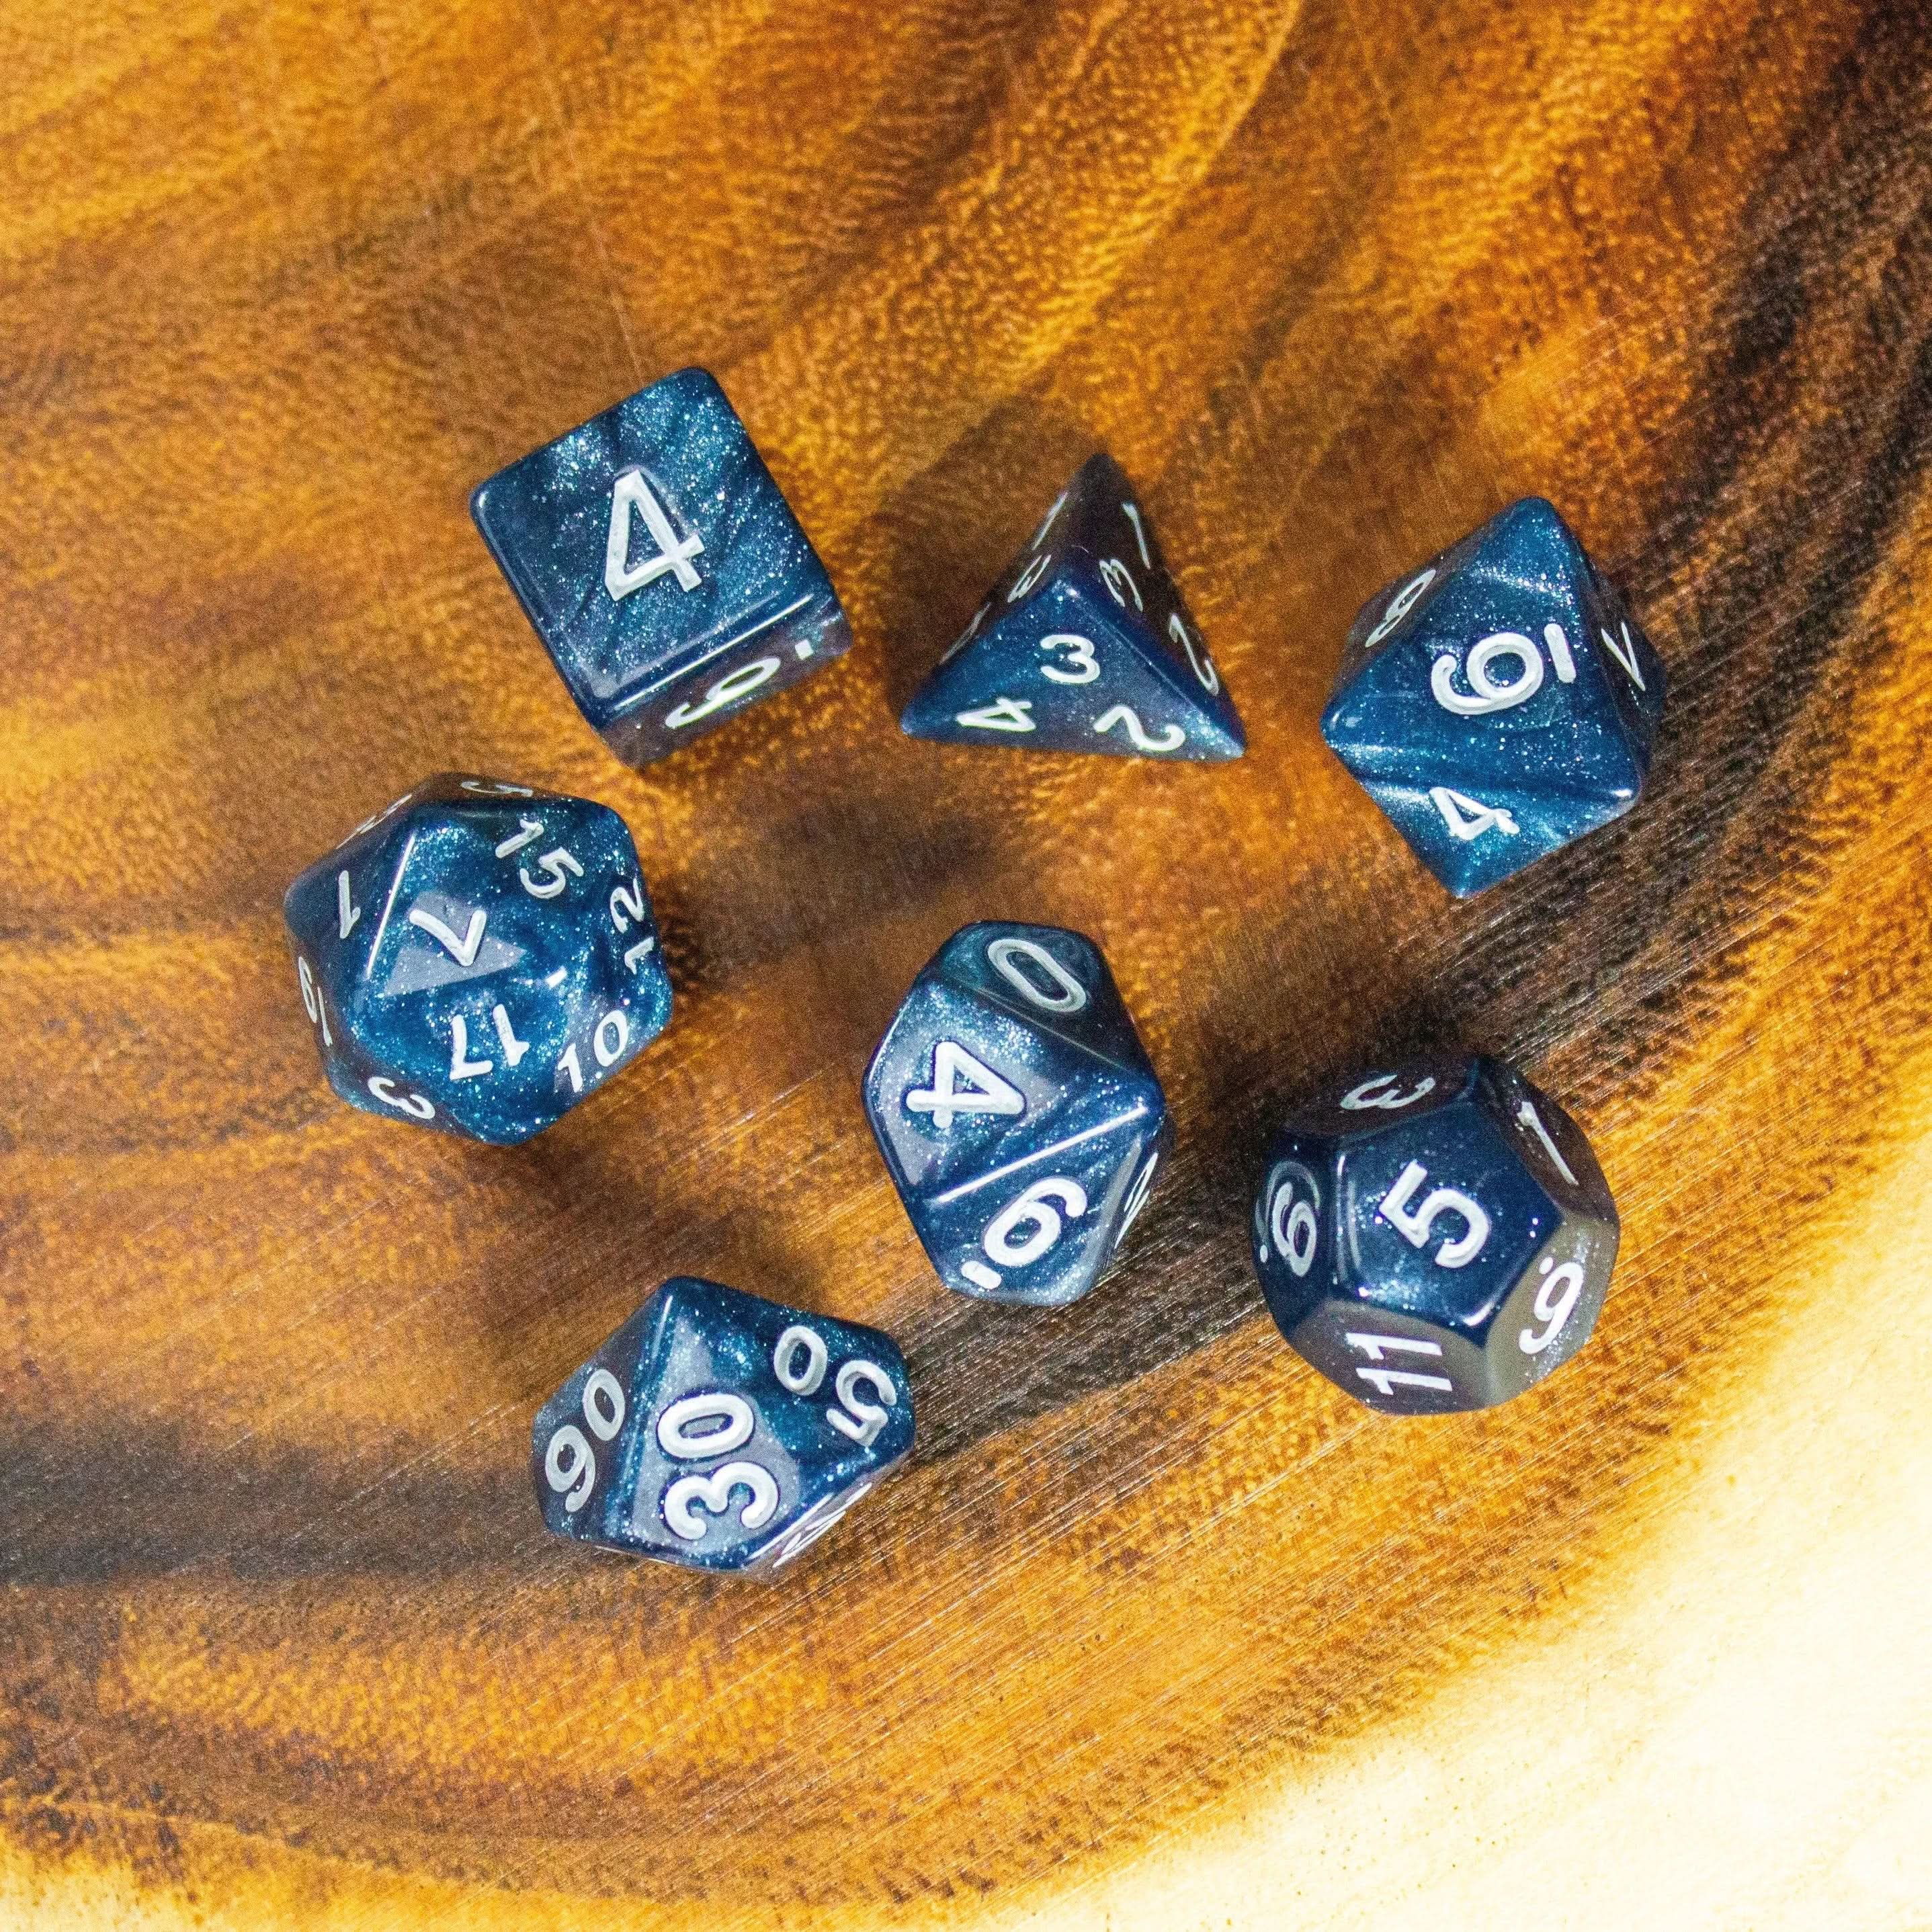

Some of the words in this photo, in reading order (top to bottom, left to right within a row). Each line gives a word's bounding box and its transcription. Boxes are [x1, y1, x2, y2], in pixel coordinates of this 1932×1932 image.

[605, 470, 705, 601] 4
[1099, 558, 1143, 612] 3
[1040, 634, 1101, 684] 3
[956, 696, 1036, 732] 4
[1093, 704, 1186, 753] 2
[1429, 787, 1519, 841] 4
[495, 818, 584, 899] 15
[409, 909, 487, 966] 7
[986, 939, 1087, 1013] 0
[449, 1004, 530, 1081] 17
[558, 1009, 629, 1093] 10
[367, 1077, 435, 1120] 3
[905, 1040, 1025, 1129] 4
[1340, 1075, 1436, 1110] 3
[1517, 1101, 1579, 1185] 1
[1379, 1159, 1490, 1268] 5
[774, 1325, 897, 1447] 50
[1346, 1333, 1452, 1395] 11
[545, 1369, 626, 1513] 90
[657, 1392, 780, 1540] 30
